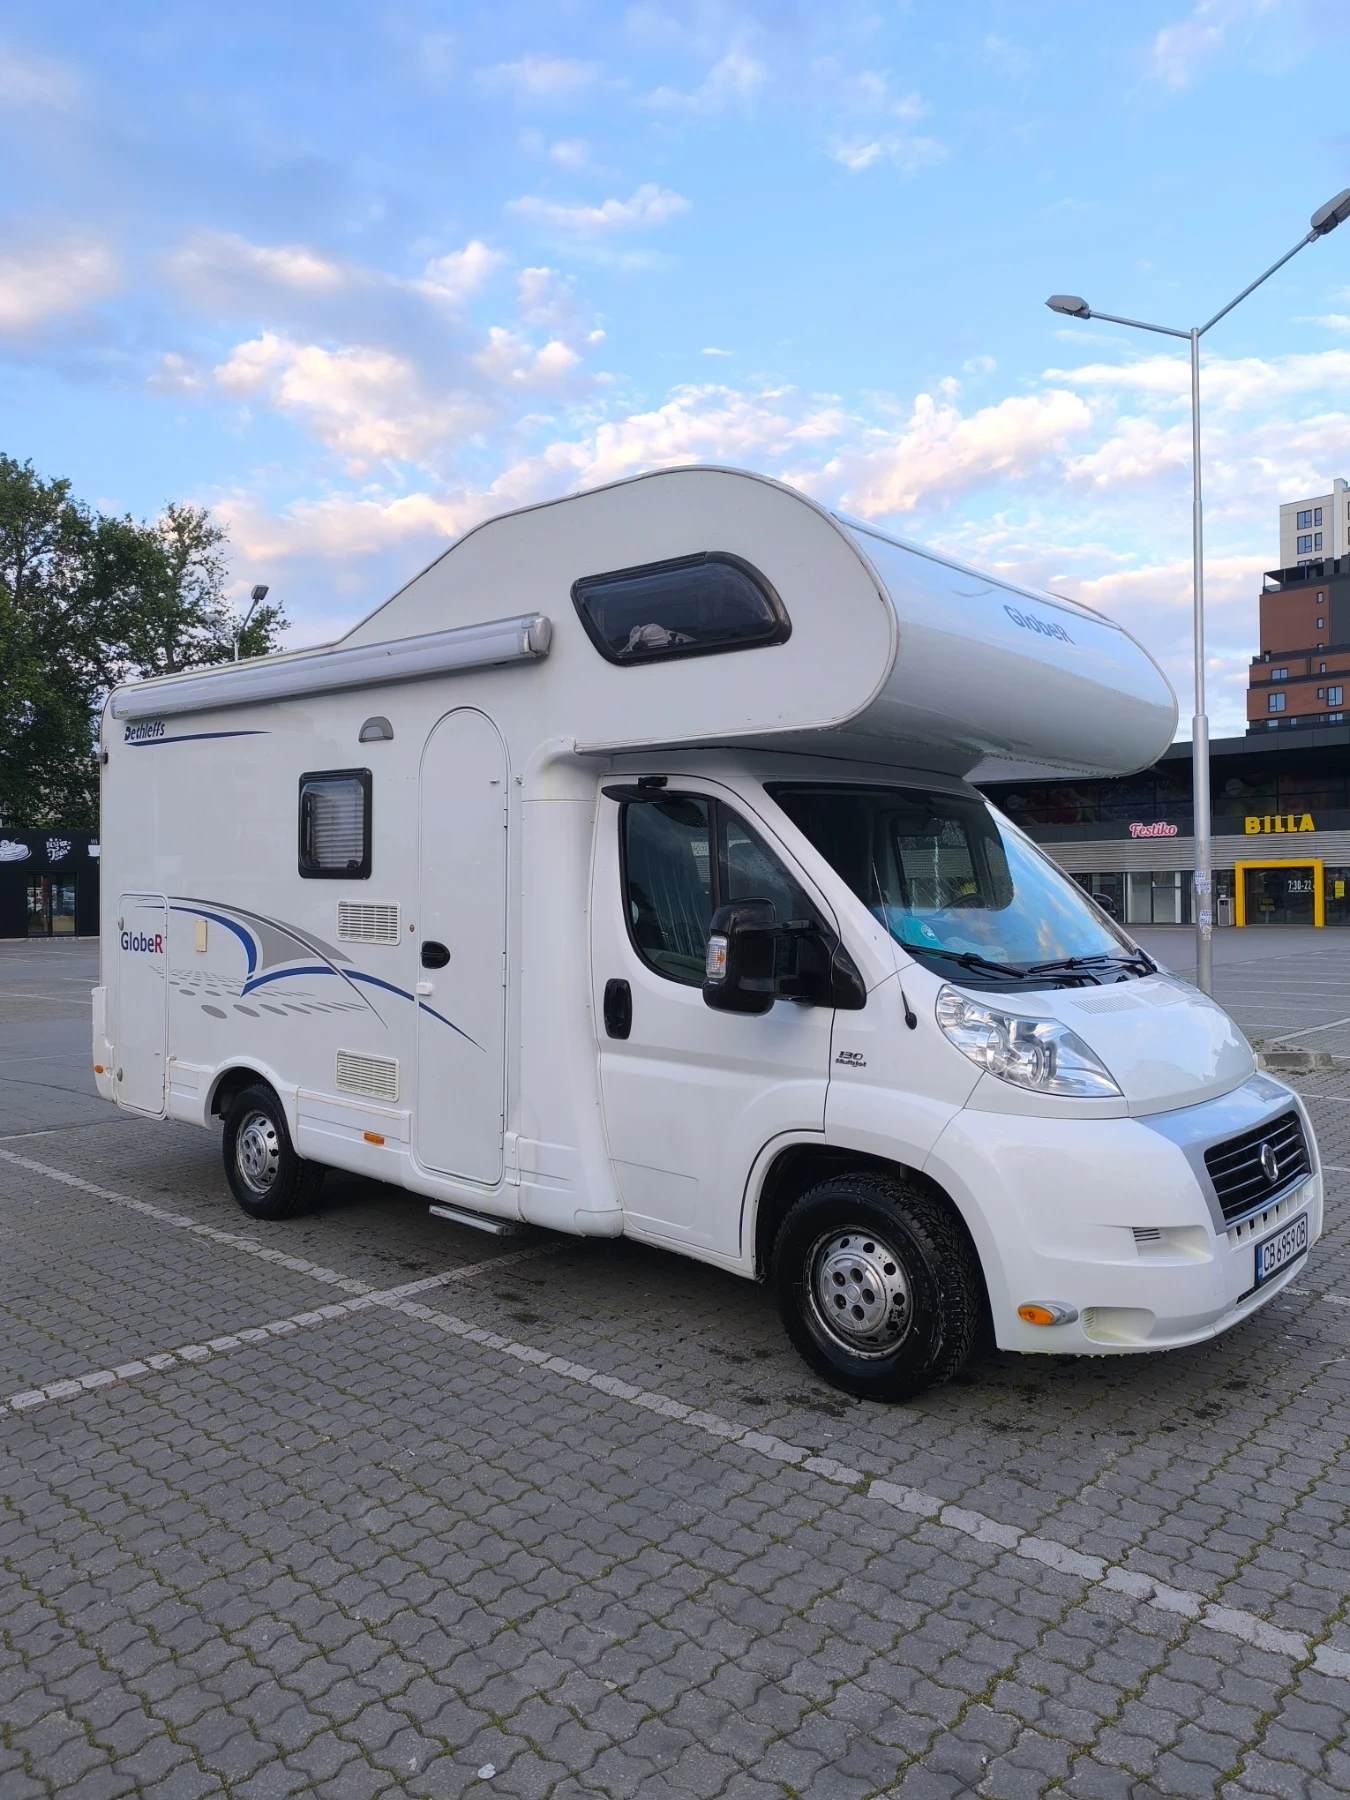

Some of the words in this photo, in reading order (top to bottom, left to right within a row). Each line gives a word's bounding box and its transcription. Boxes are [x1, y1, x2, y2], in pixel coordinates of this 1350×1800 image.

[1003, 604, 1076, 645] GlobeR
[124, 721, 165, 741] Dethleffs
[1129, 822, 1178, 838] Festiko
[1245, 813, 1315, 834] BILLA
[120, 931, 164, 954] GlobeR
[838, 1051, 864, 1061] 130
